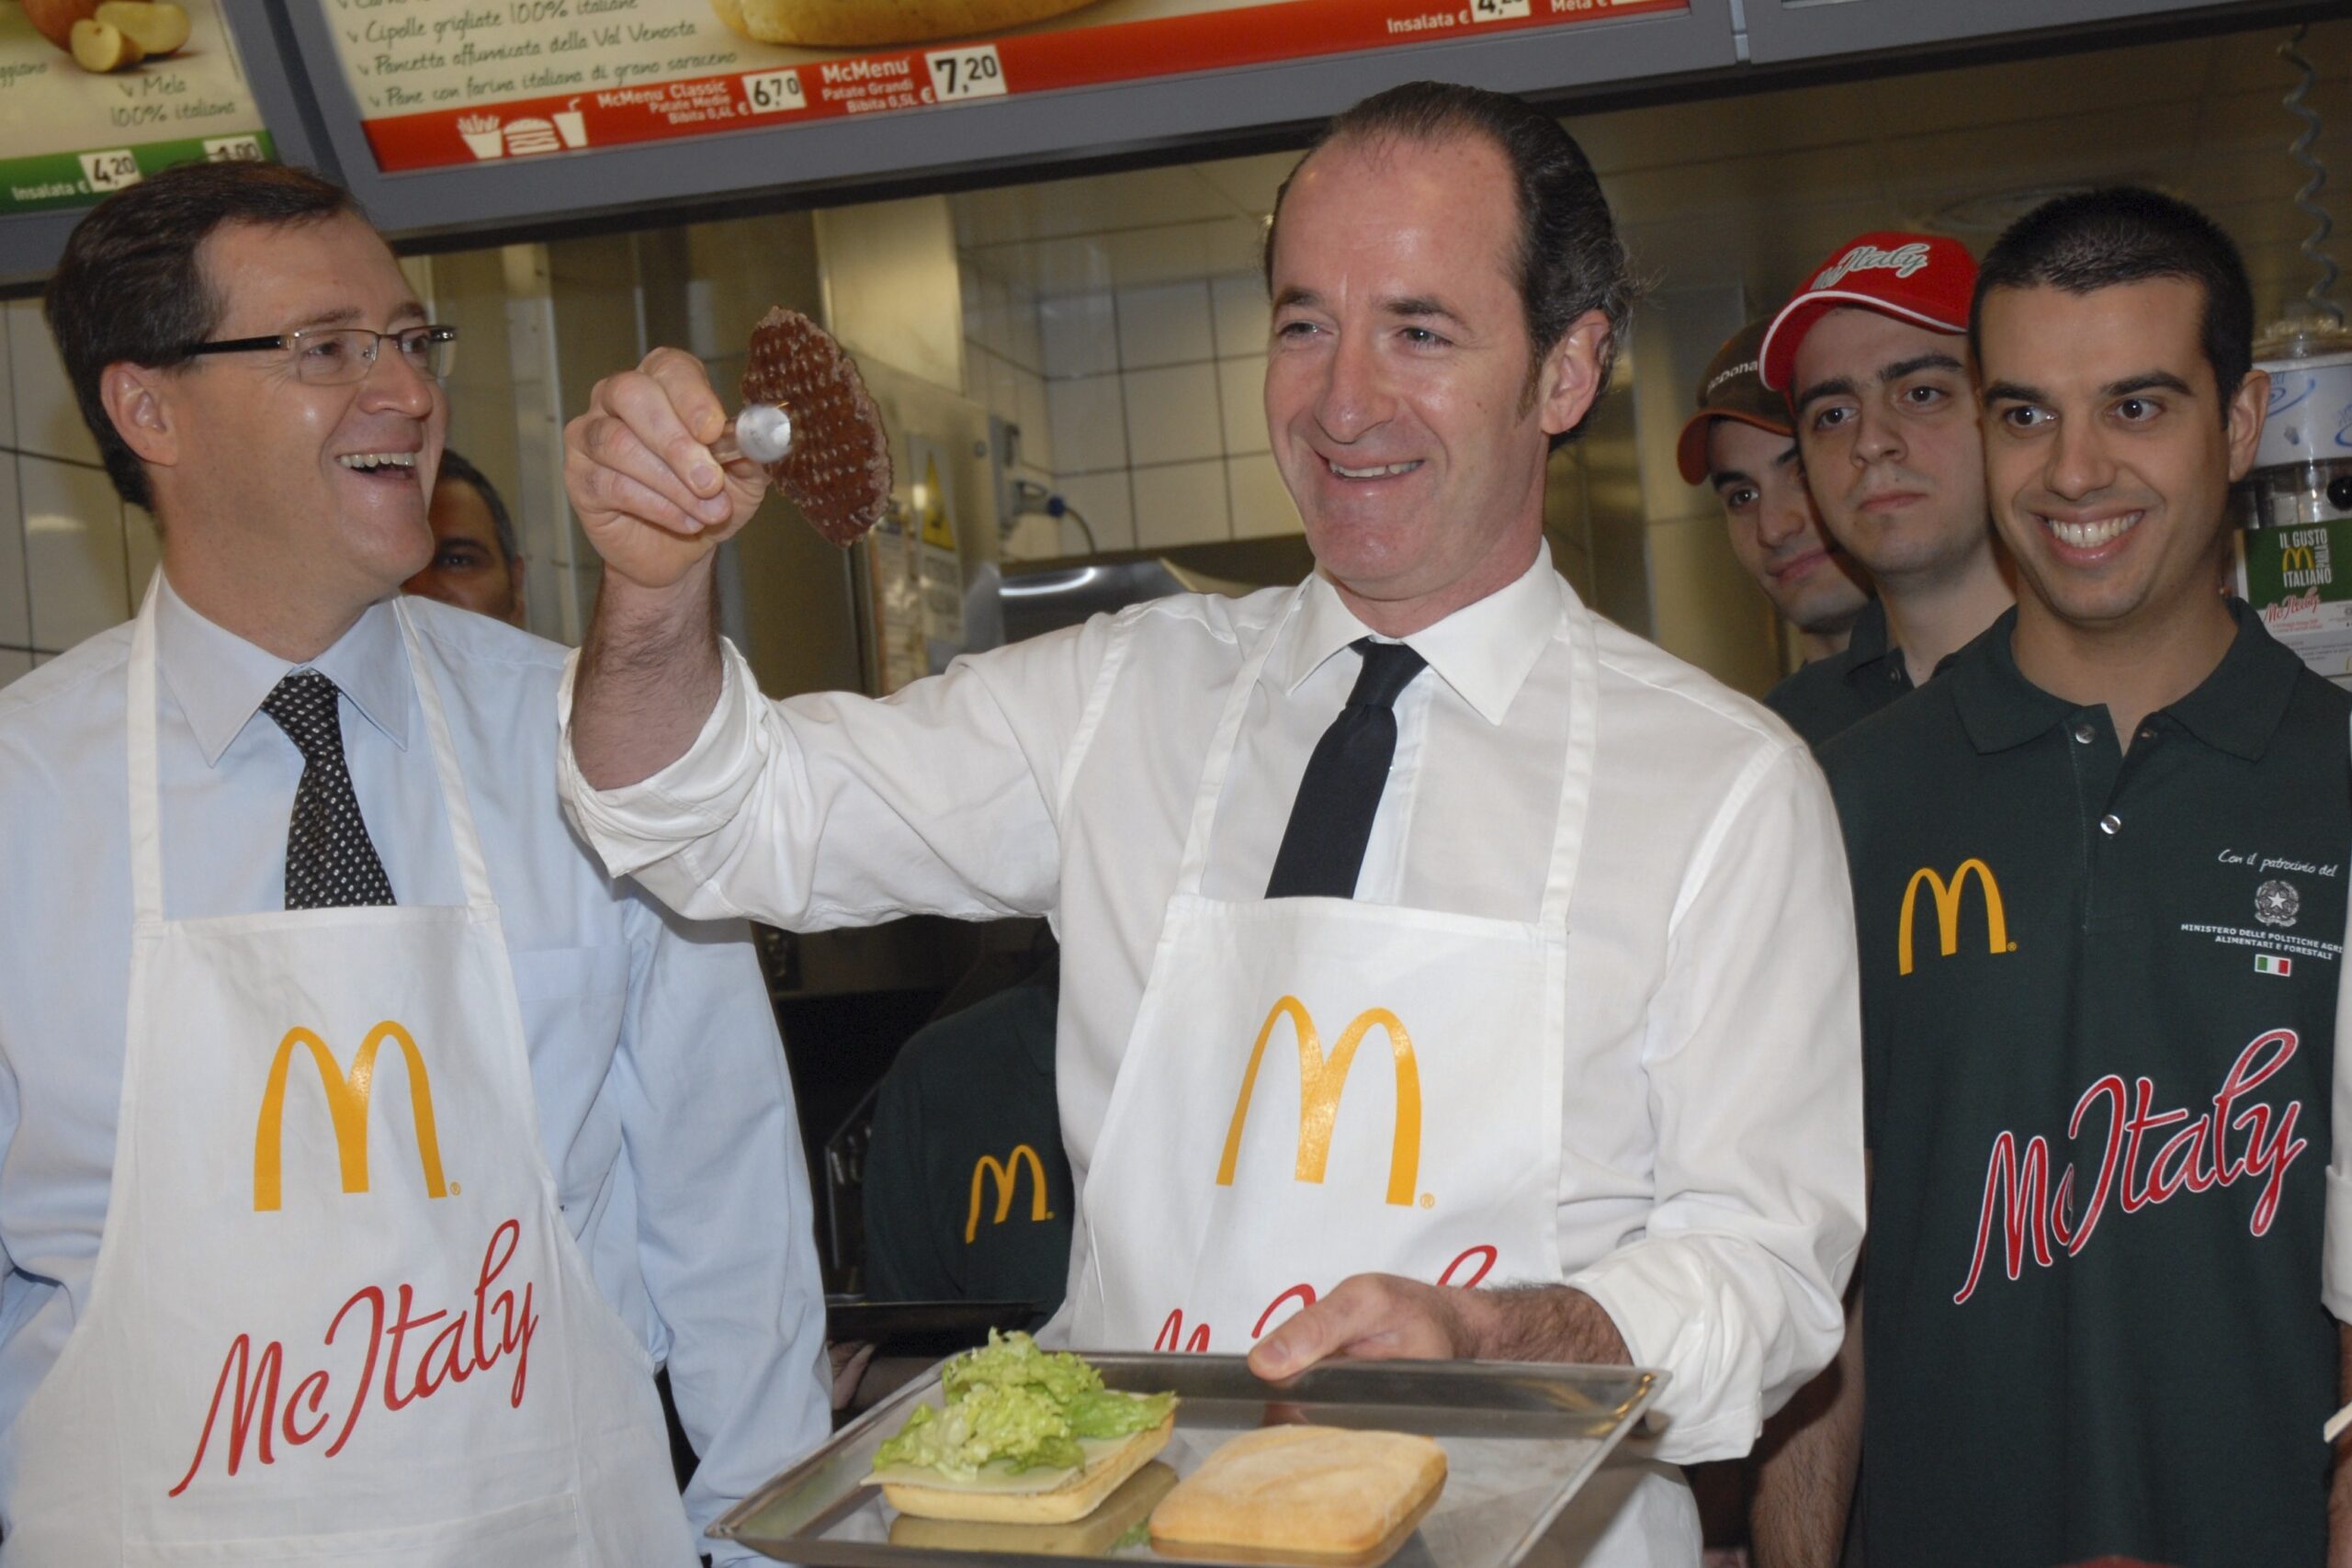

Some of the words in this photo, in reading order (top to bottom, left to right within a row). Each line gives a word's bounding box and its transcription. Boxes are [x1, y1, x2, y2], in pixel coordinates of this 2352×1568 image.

[366, 17, 426, 48] Cipolle
[434, 10, 503, 42] grigliate
[509, 1, 569, 24] 100%
[1387, 13, 1454, 34] Insalata
[375, 53, 445, 75] Pancetta
[453, 39, 540, 66] affumicata
[550, 29, 588, 53] della
[593, 26, 620, 47] Val
[628, 20, 696, 43] Venosta
[143, 73, 187, 96] Mela
[386, 86, 425, 107] Pane
[434, 87, 459, 101] con
[467, 76, 514, 98] farina
[591, 63, 608, 80] di
[614, 62, 660, 87] grano
[667, 51, 738, 72] saraceno
[669, 80, 728, 99] Classic
[821, 86, 865, 101] Patate
[867, 79, 914, 96] Grandi
[846, 97, 887, 114] Bibita
[934, 55, 998, 94] 7,20
[649, 99, 691, 114] Patate
[667, 109, 706, 124] Bibita
[753, 77, 800, 107] 6,70
[110, 104, 167, 127] 100%
[11, 183, 75, 201] Insalata
[2279, 533, 2290, 549] IL
[2292, 528, 2328, 547] GUSTO
[2283, 568, 2332, 588] ITALIANO
[2218, 849, 2243, 863] Con
[2246, 852, 2257, 865] il
[2259, 856, 2315, 873] patrocinio
[2319, 863, 2338, 877] del
[2180, 923, 2237, 936] MINISTERO
[2239, 929, 2267, 940] DELLE
[2268, 932, 2319, 948] POLITICHE
[2215, 935, 2273, 950] ALIMENTARI
[2283, 944, 2333, 961] FORESTALI
